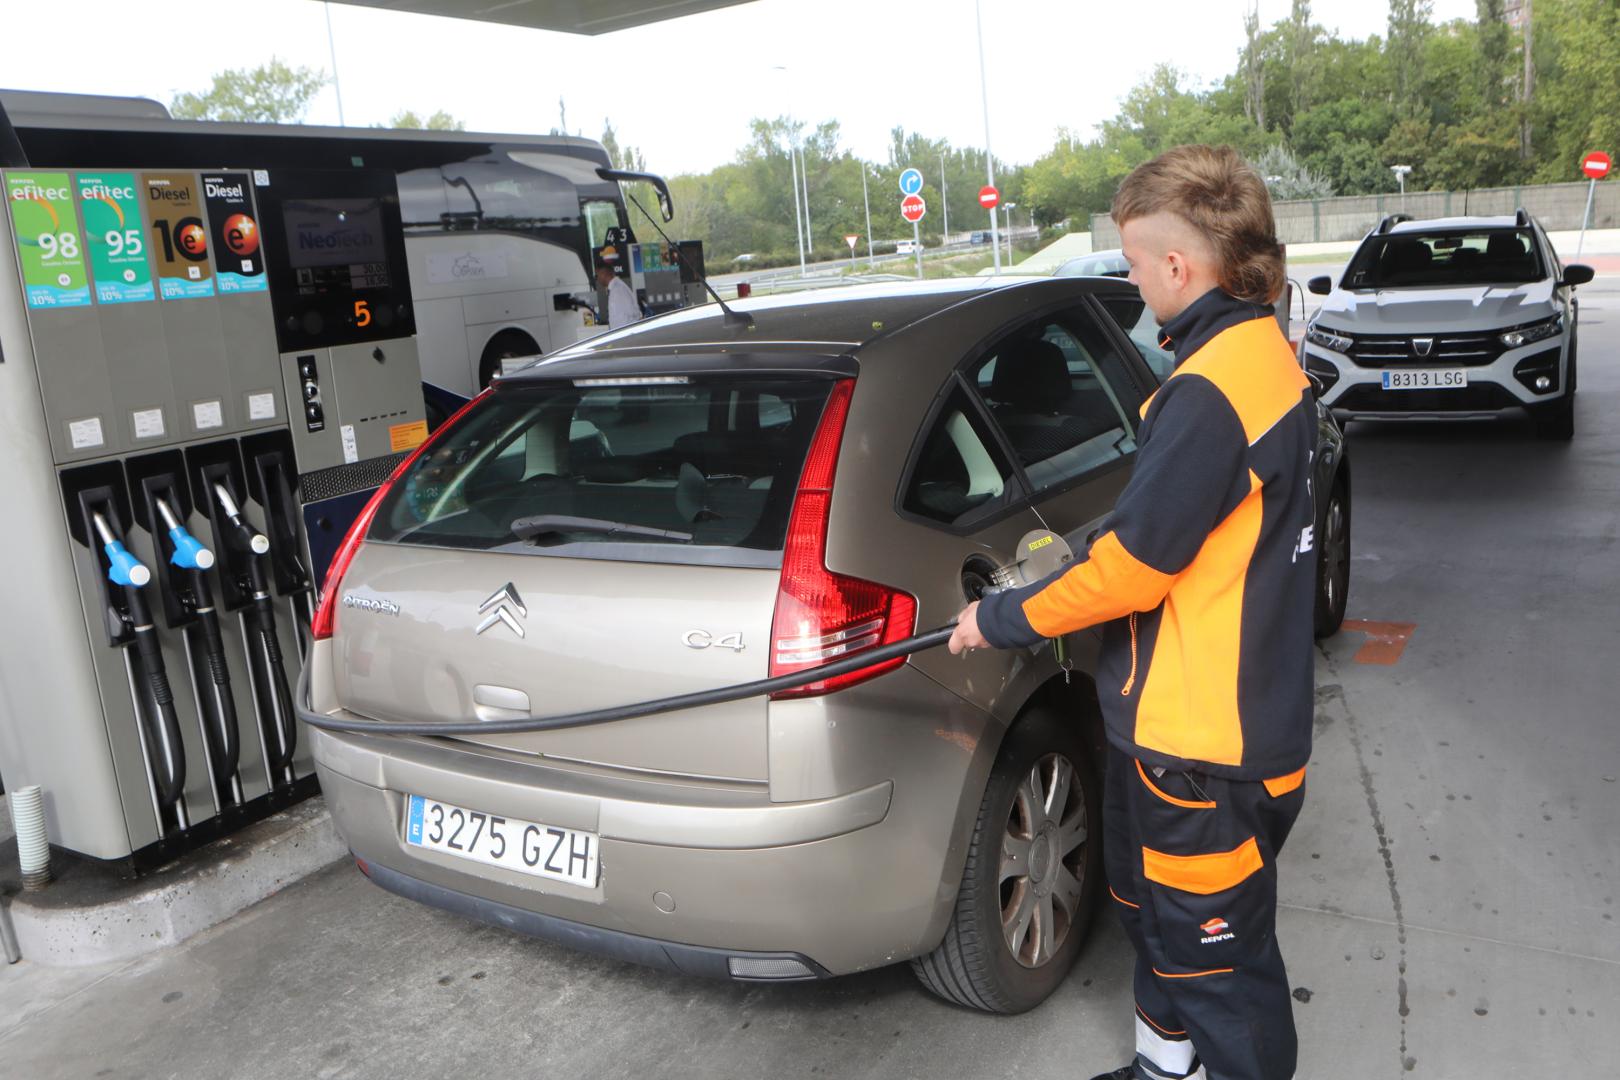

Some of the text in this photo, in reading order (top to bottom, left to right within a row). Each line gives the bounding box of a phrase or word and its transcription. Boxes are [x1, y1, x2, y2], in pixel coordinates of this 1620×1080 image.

[12, 185, 70, 200] efitec
[82, 185, 134, 200] efitec
[150, 187, 190, 201] Diesel
[205, 184, 243, 198] Diesel
[902, 204, 924, 213] STOP
[606, 230, 615, 242] 4
[620, 228, 628, 242] 3
[38, 231, 78, 260] 98
[105, 229, 142, 257] 95
[32, 295, 56, 305] 10%
[354, 300, 371, 327] 5
[1392, 371, 1463, 387] 8313 LSG
[681, 629, 746, 653] C4
[412, 804, 590, 880] E 3275 GZH
